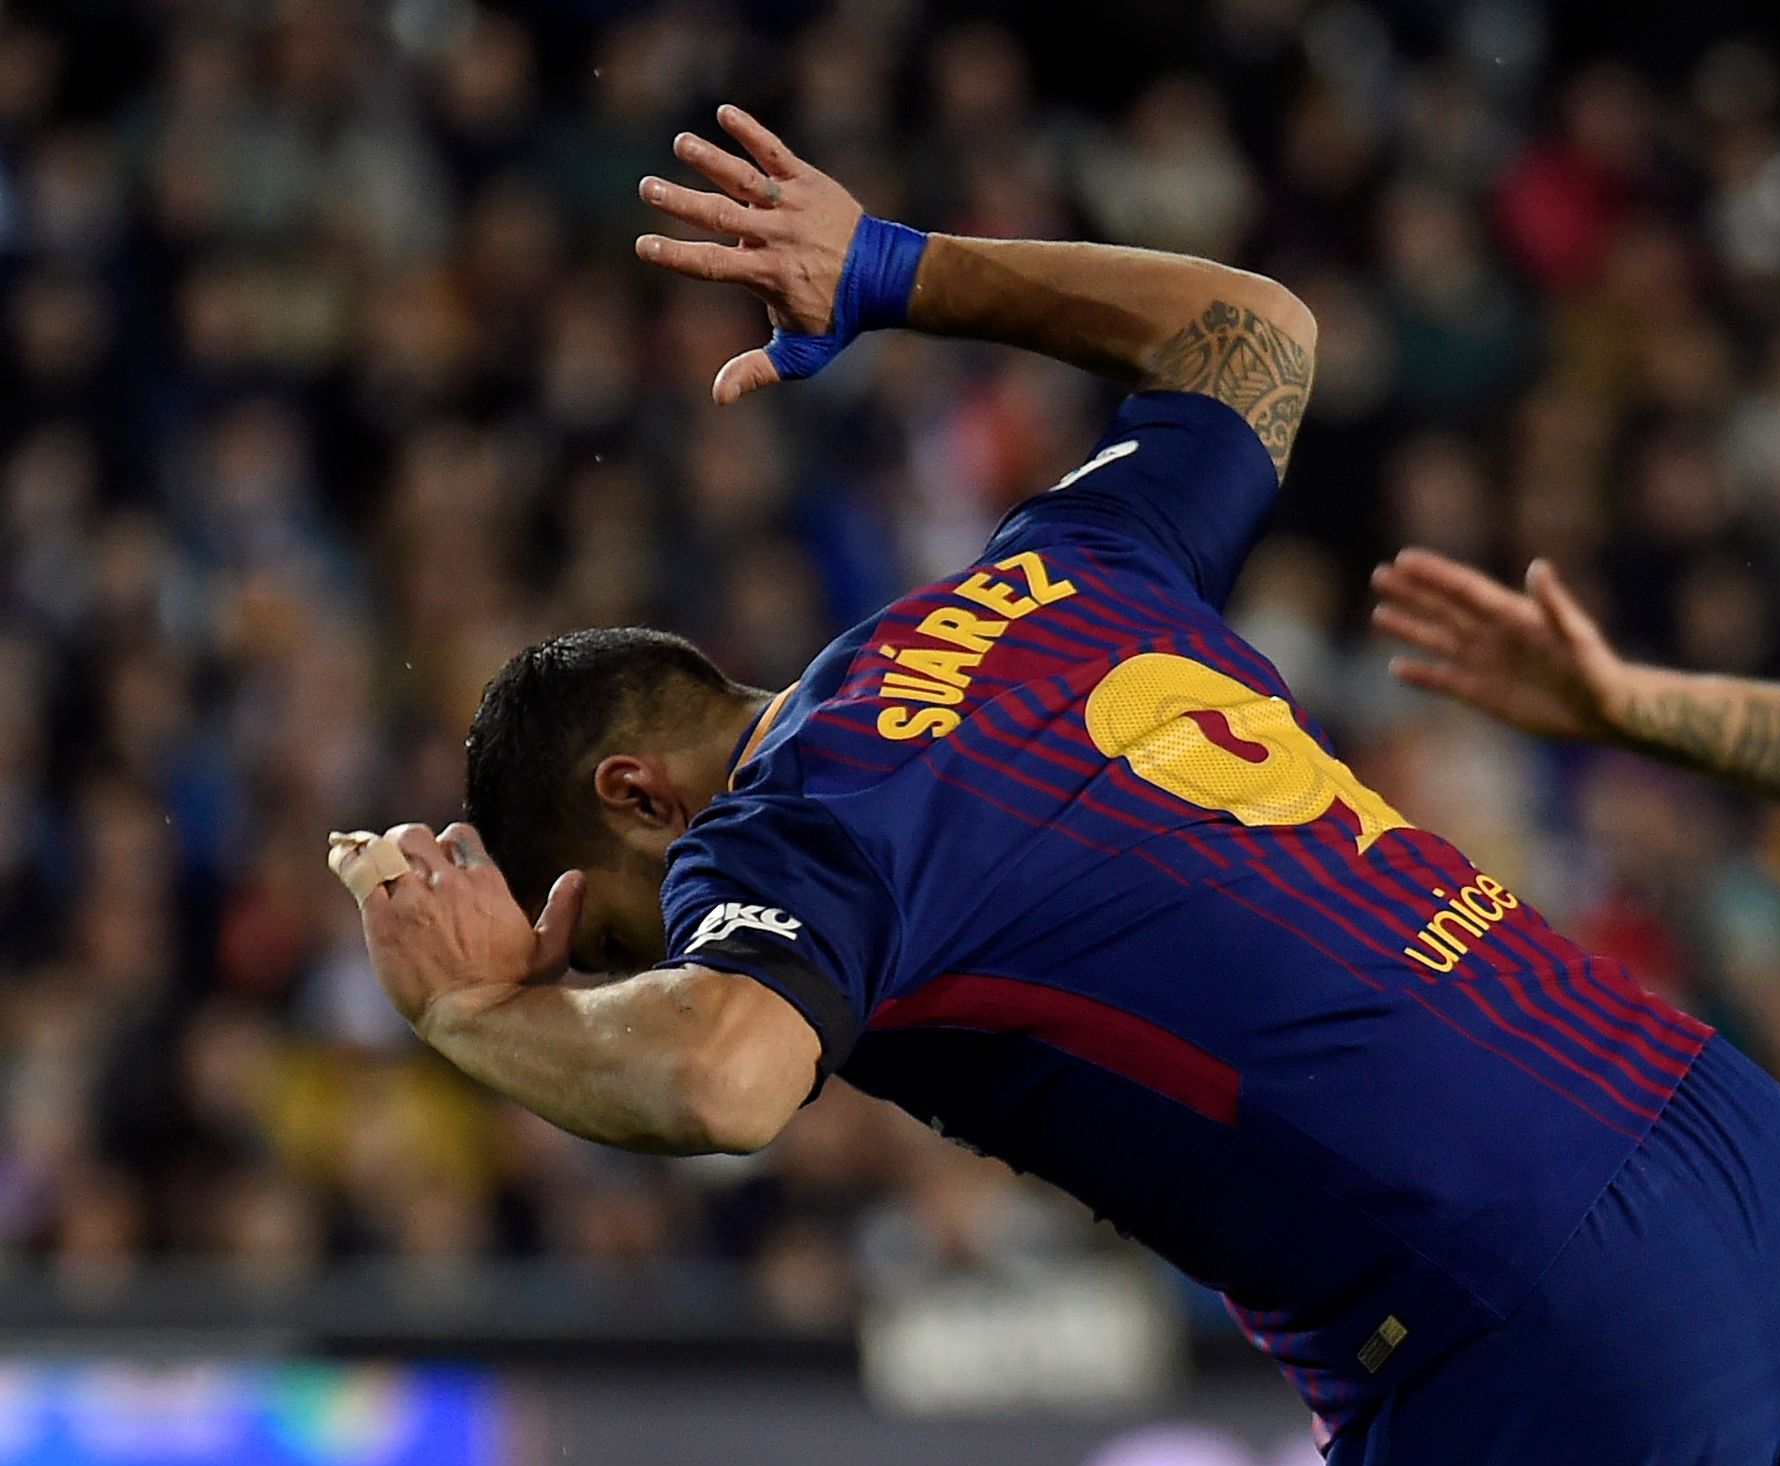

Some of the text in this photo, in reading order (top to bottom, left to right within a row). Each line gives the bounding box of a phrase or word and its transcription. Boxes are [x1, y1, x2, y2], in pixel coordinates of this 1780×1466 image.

[877, 551, 1078, 741] SUÁREZ
[1085, 653, 1416, 855] 9
[1404, 874, 1518, 973] unice
